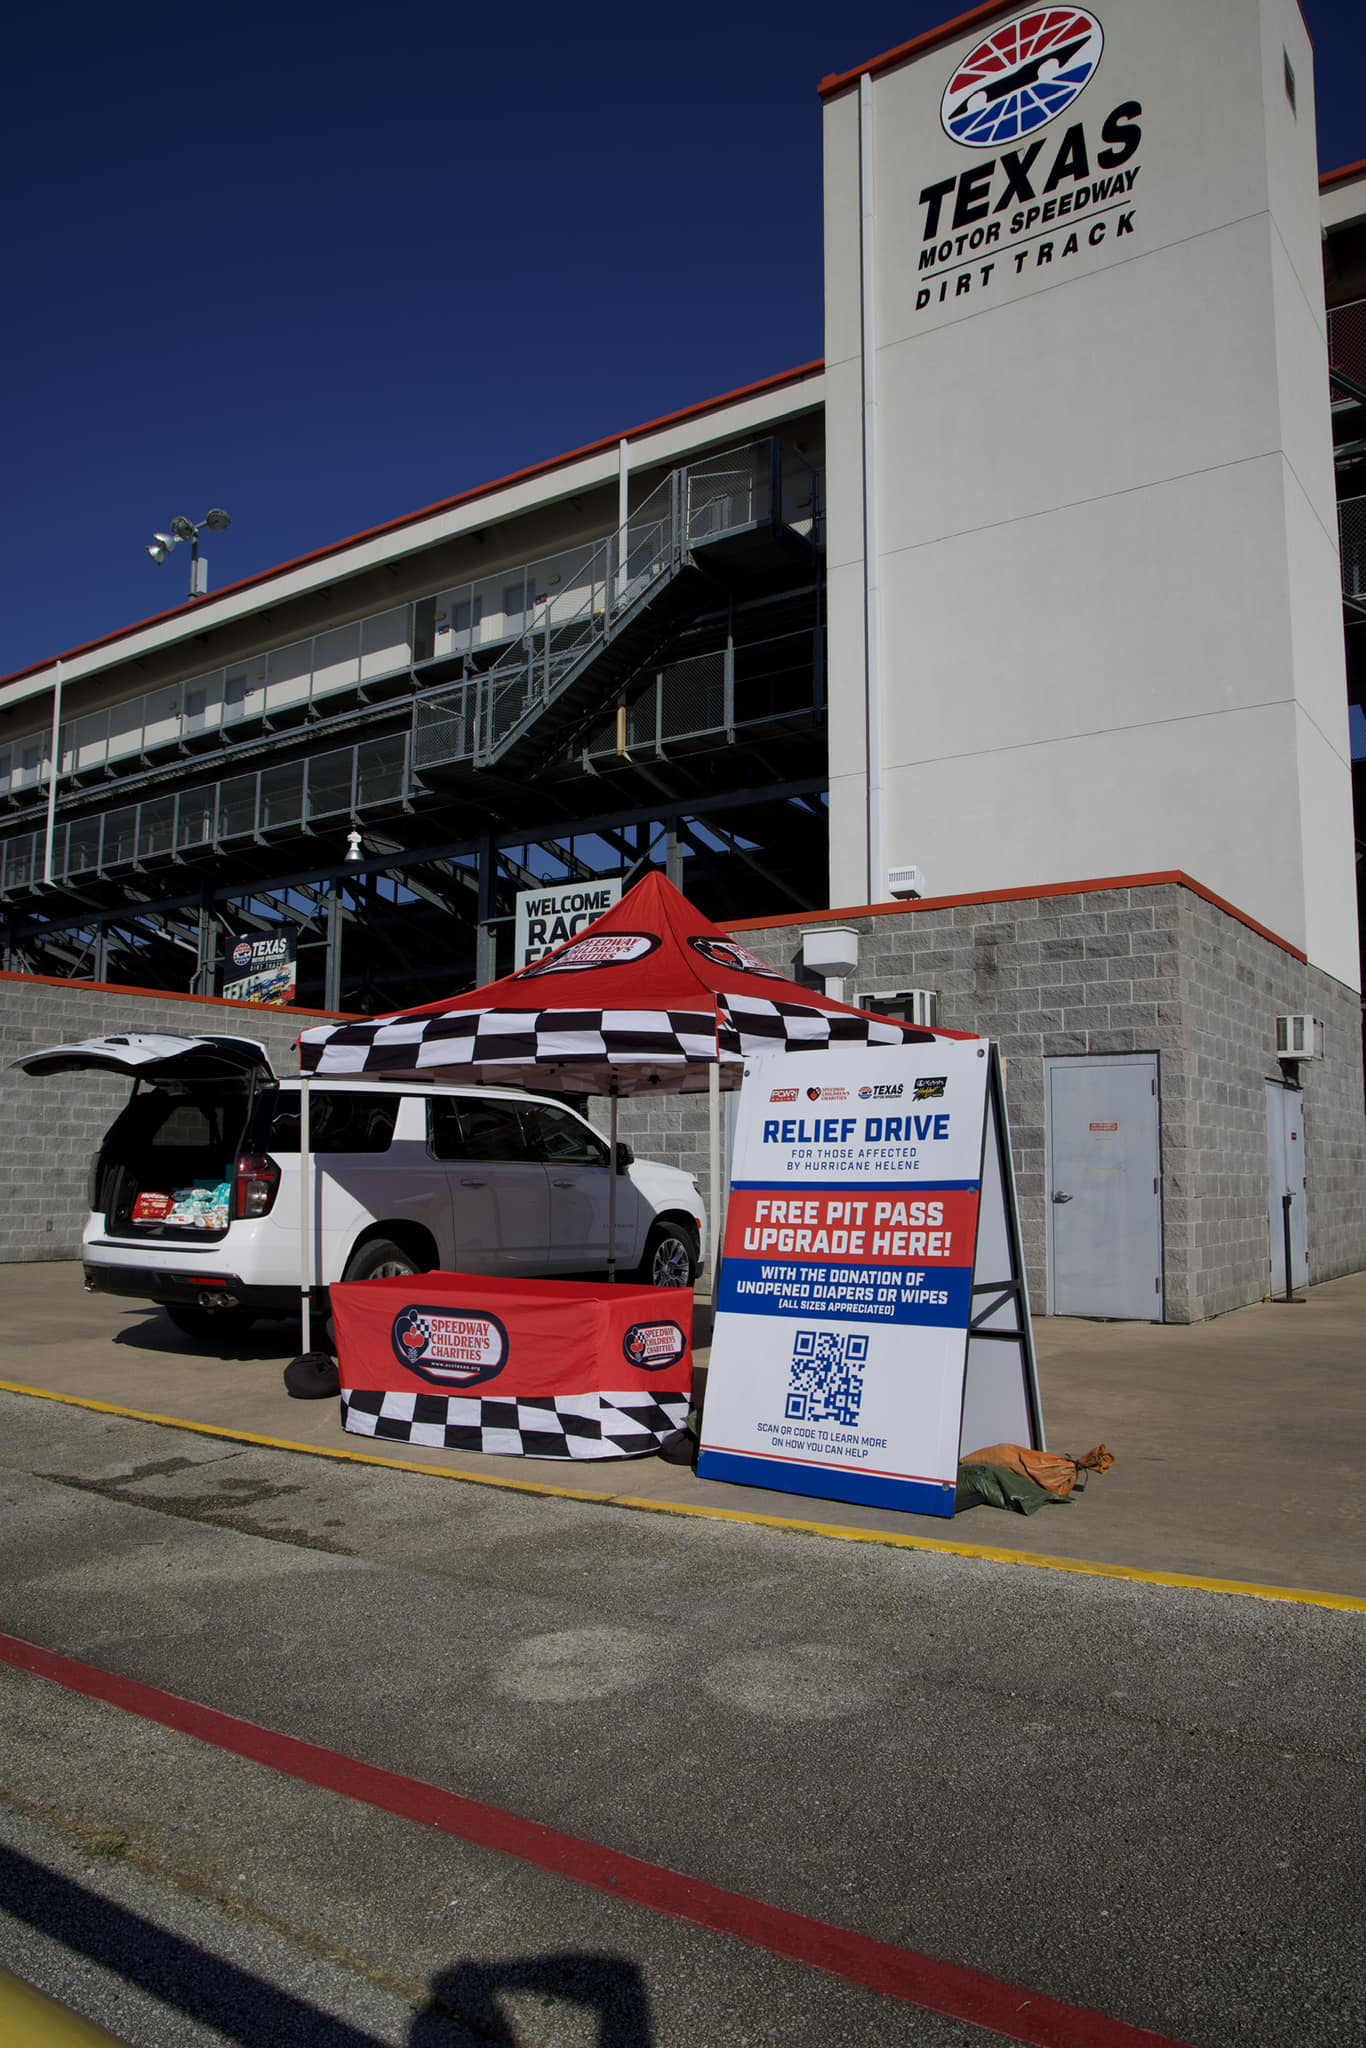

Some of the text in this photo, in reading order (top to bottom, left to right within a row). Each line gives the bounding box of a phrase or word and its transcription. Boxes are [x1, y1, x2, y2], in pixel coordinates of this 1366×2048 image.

[918, 101, 1142, 241] TEXAS
[918, 166, 1141, 271] MOTOR SPEEDWAY
[915, 210, 1136, 311] DIRT TRACK
[525, 890, 611, 918] WELCOME
[252, 938, 287, 957] TEXAS
[873, 1083, 904, 1095] TEXAS
[763, 1114, 950, 1143] RELIEF DRIVE
[791, 1147, 917, 1159] FOR THOSE AFFECTED
[787, 1160, 920, 1171] BY HURRICANE HELENE
[755, 1200, 944, 1226] FREE PIT PASS
[743, 1227, 952, 1257] UPGRADE HERE!
[761, 1265, 925, 1286] WITH THE DONATION OF
[736, 1280, 948, 1305] UNOPENED DIAPERS OR WIPES
[800, 1300, 827, 1311] SIZES
[431, 1319, 490, 1337] SPEEDWAY
[431, 1333, 490, 1350] CHILDREN'S
[431, 1346, 482, 1361] CHARITIES
[757, 1422, 887, 1448] SCAN QR CODE TO LEARN MORE
[772, 1437, 868, 1458] ON HOW YOU CAN HELP
